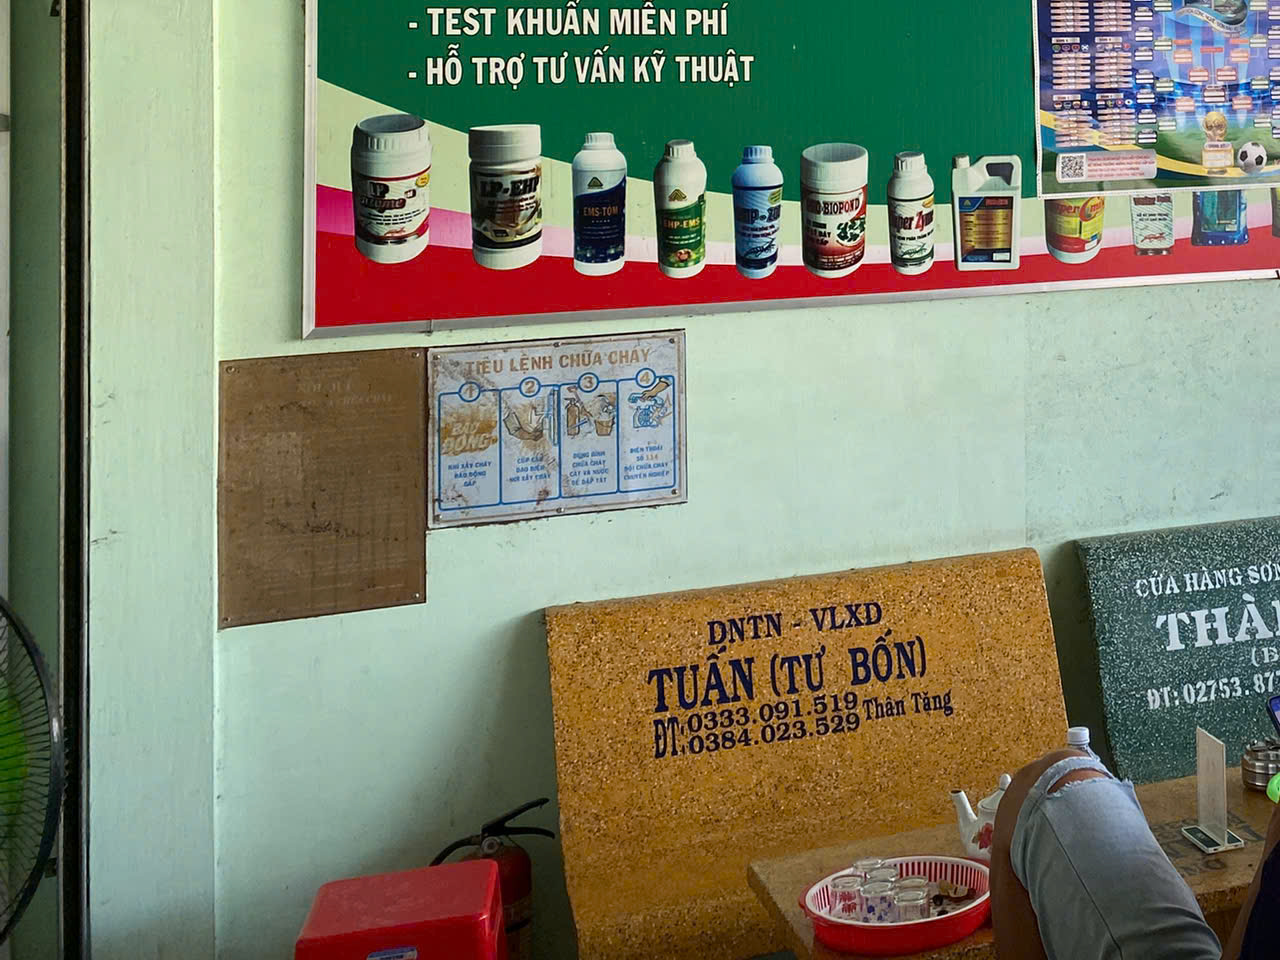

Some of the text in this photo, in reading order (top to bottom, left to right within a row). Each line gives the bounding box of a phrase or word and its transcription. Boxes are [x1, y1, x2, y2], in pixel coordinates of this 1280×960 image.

[427, 7, 497, 35] TEST
[685, 2, 729, 36] PHÍ
[426, 44, 755, 89] HỖ TRỢ TƯ VẤN KỸ THUẬT
[464, 348, 651, 377] TIÊU LỆNH CHỮA CHÁY
[640, 372, 651, 385] 4
[525, 381, 535, 394] 2
[583, 376, 593, 389] 3
[1135, 569, 1180, 598] CỬA
[1183, 567, 1244, 593] HÀNG
[707, 602, 883, 645] DNTN VLXD
[648, 629, 927, 713] TUẤN (TƯ BỐN)
[687, 692, 858, 733] 0333.091.519
[687, 690, 954, 755] 0384.023.529 Thân Tăng
